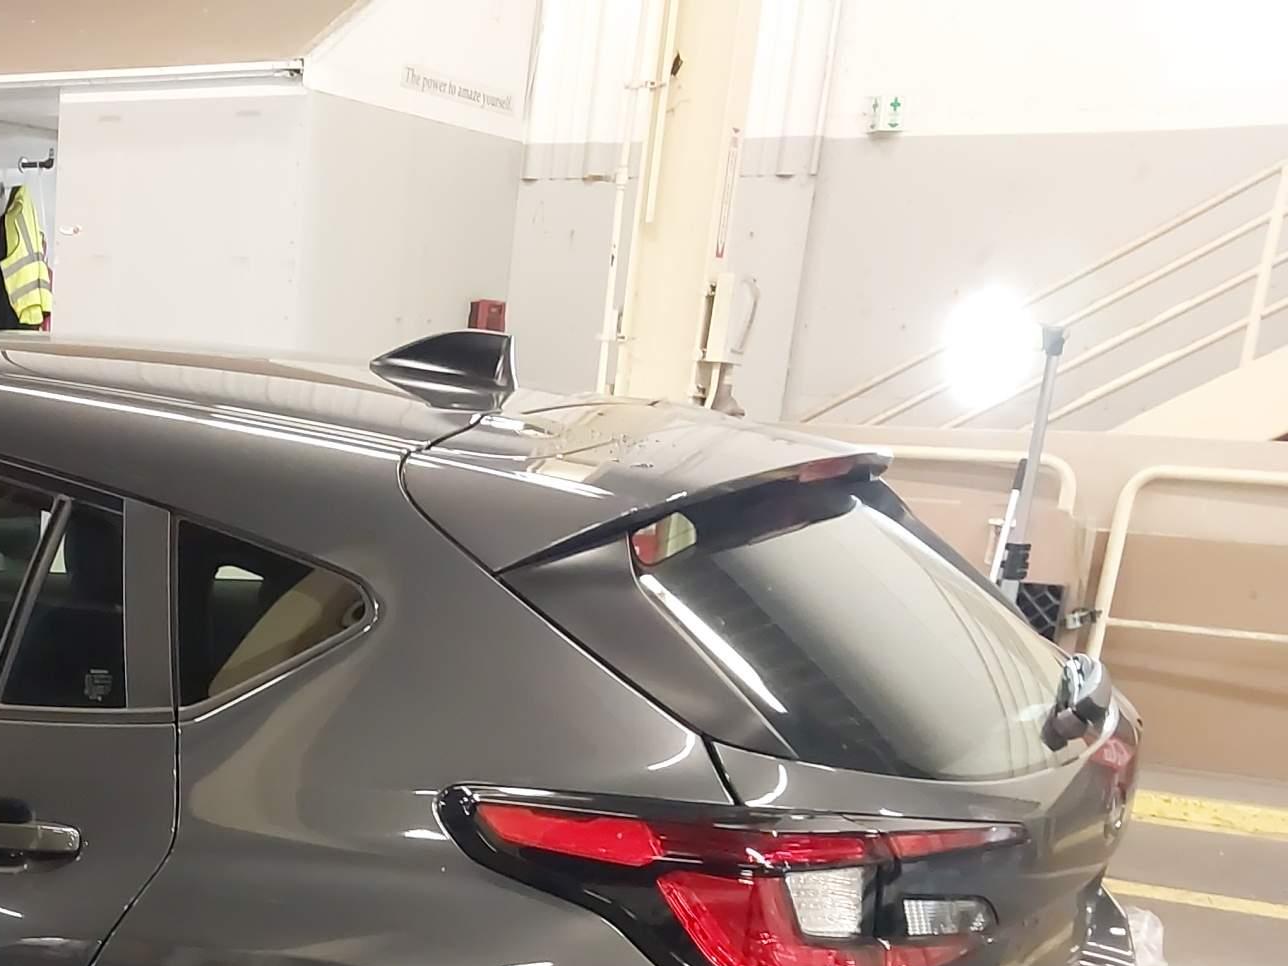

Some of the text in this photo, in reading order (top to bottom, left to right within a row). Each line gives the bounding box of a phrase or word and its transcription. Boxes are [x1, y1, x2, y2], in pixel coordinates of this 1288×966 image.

[405, 66, 421, 86] The
[421, 77, 447, 92] power
[448, 80, 457, 96] to
